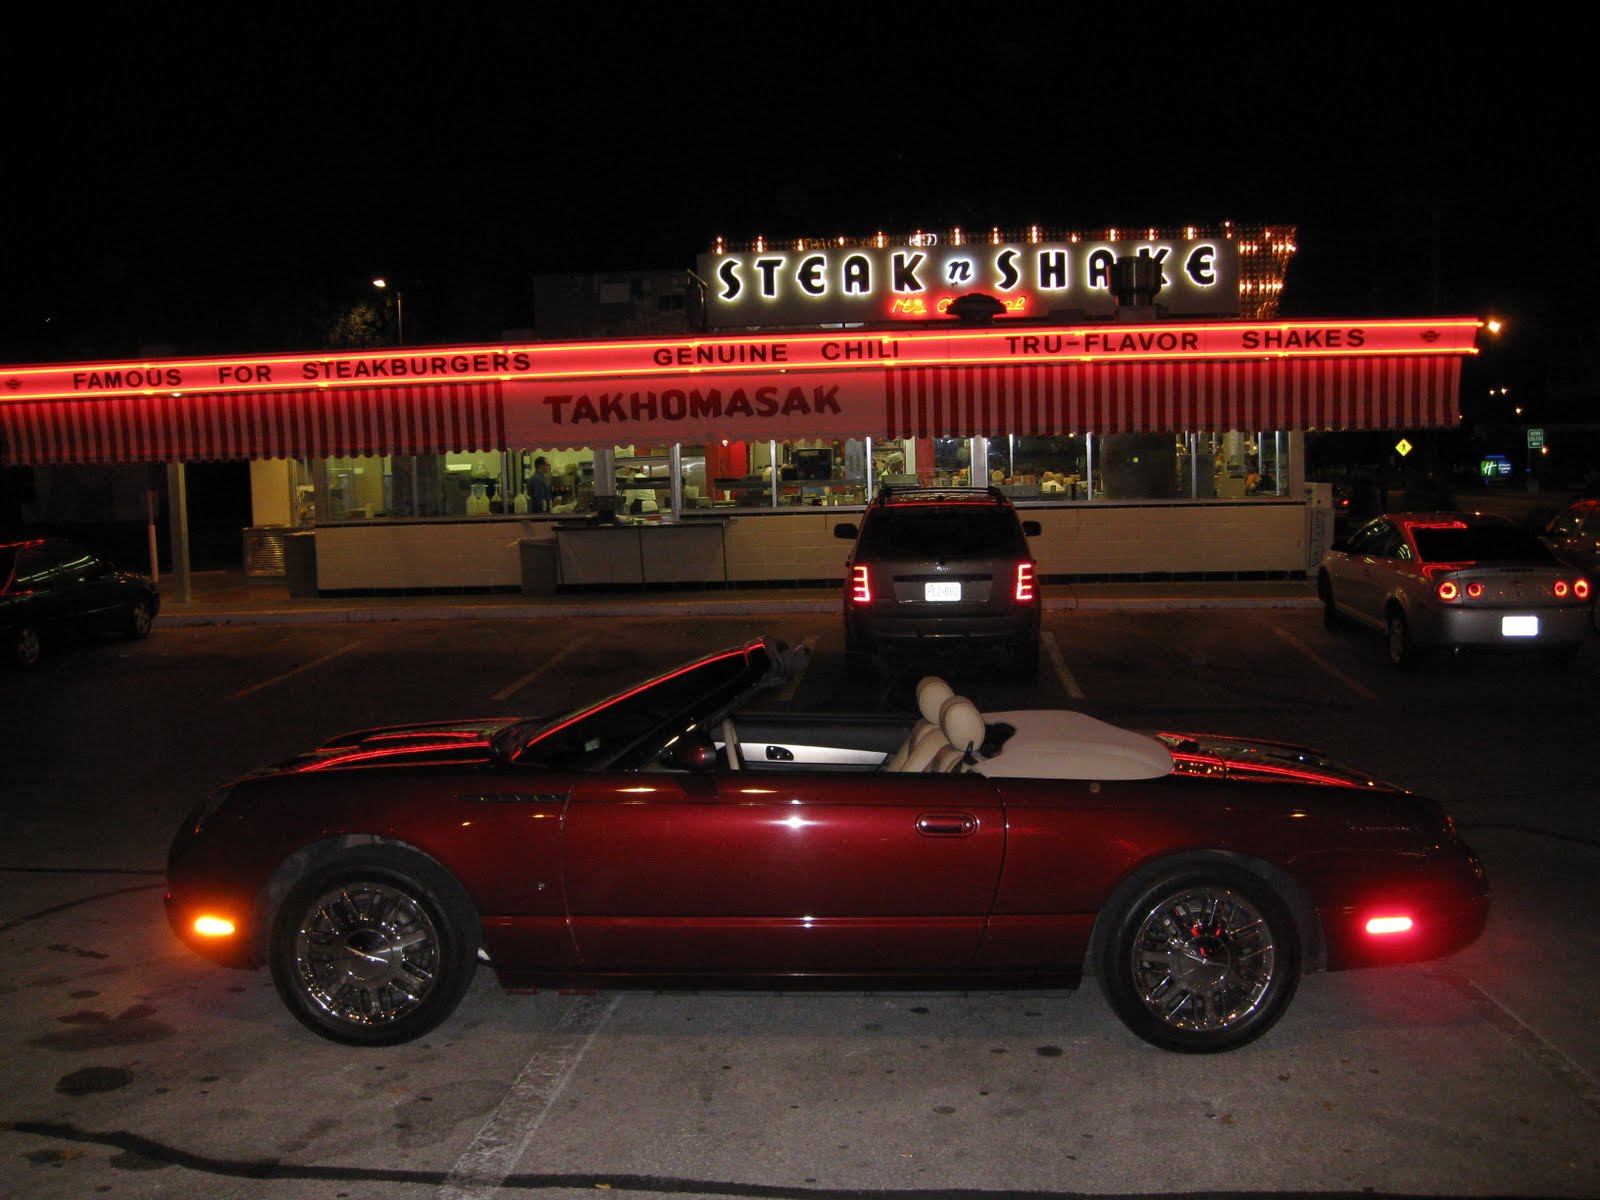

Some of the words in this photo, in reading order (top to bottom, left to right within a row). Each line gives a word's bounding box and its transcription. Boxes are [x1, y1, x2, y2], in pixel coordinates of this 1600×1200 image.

[717, 251, 926, 302] STEAK
[949, 257, 973, 283] n
[73, 368, 182, 391] FAMOUS
[218, 364, 272, 385] FOR
[302, 352, 531, 381] STEAKBURGERS
[653, 343, 788, 366] GENUINE
[820, 340, 899, 361] CHILI
[1005, 331, 1199, 355] TRU-FLAVOR
[1242, 328, 1365, 350] SHAKES
[542, 384, 842, 425] TAKHOMASAK
